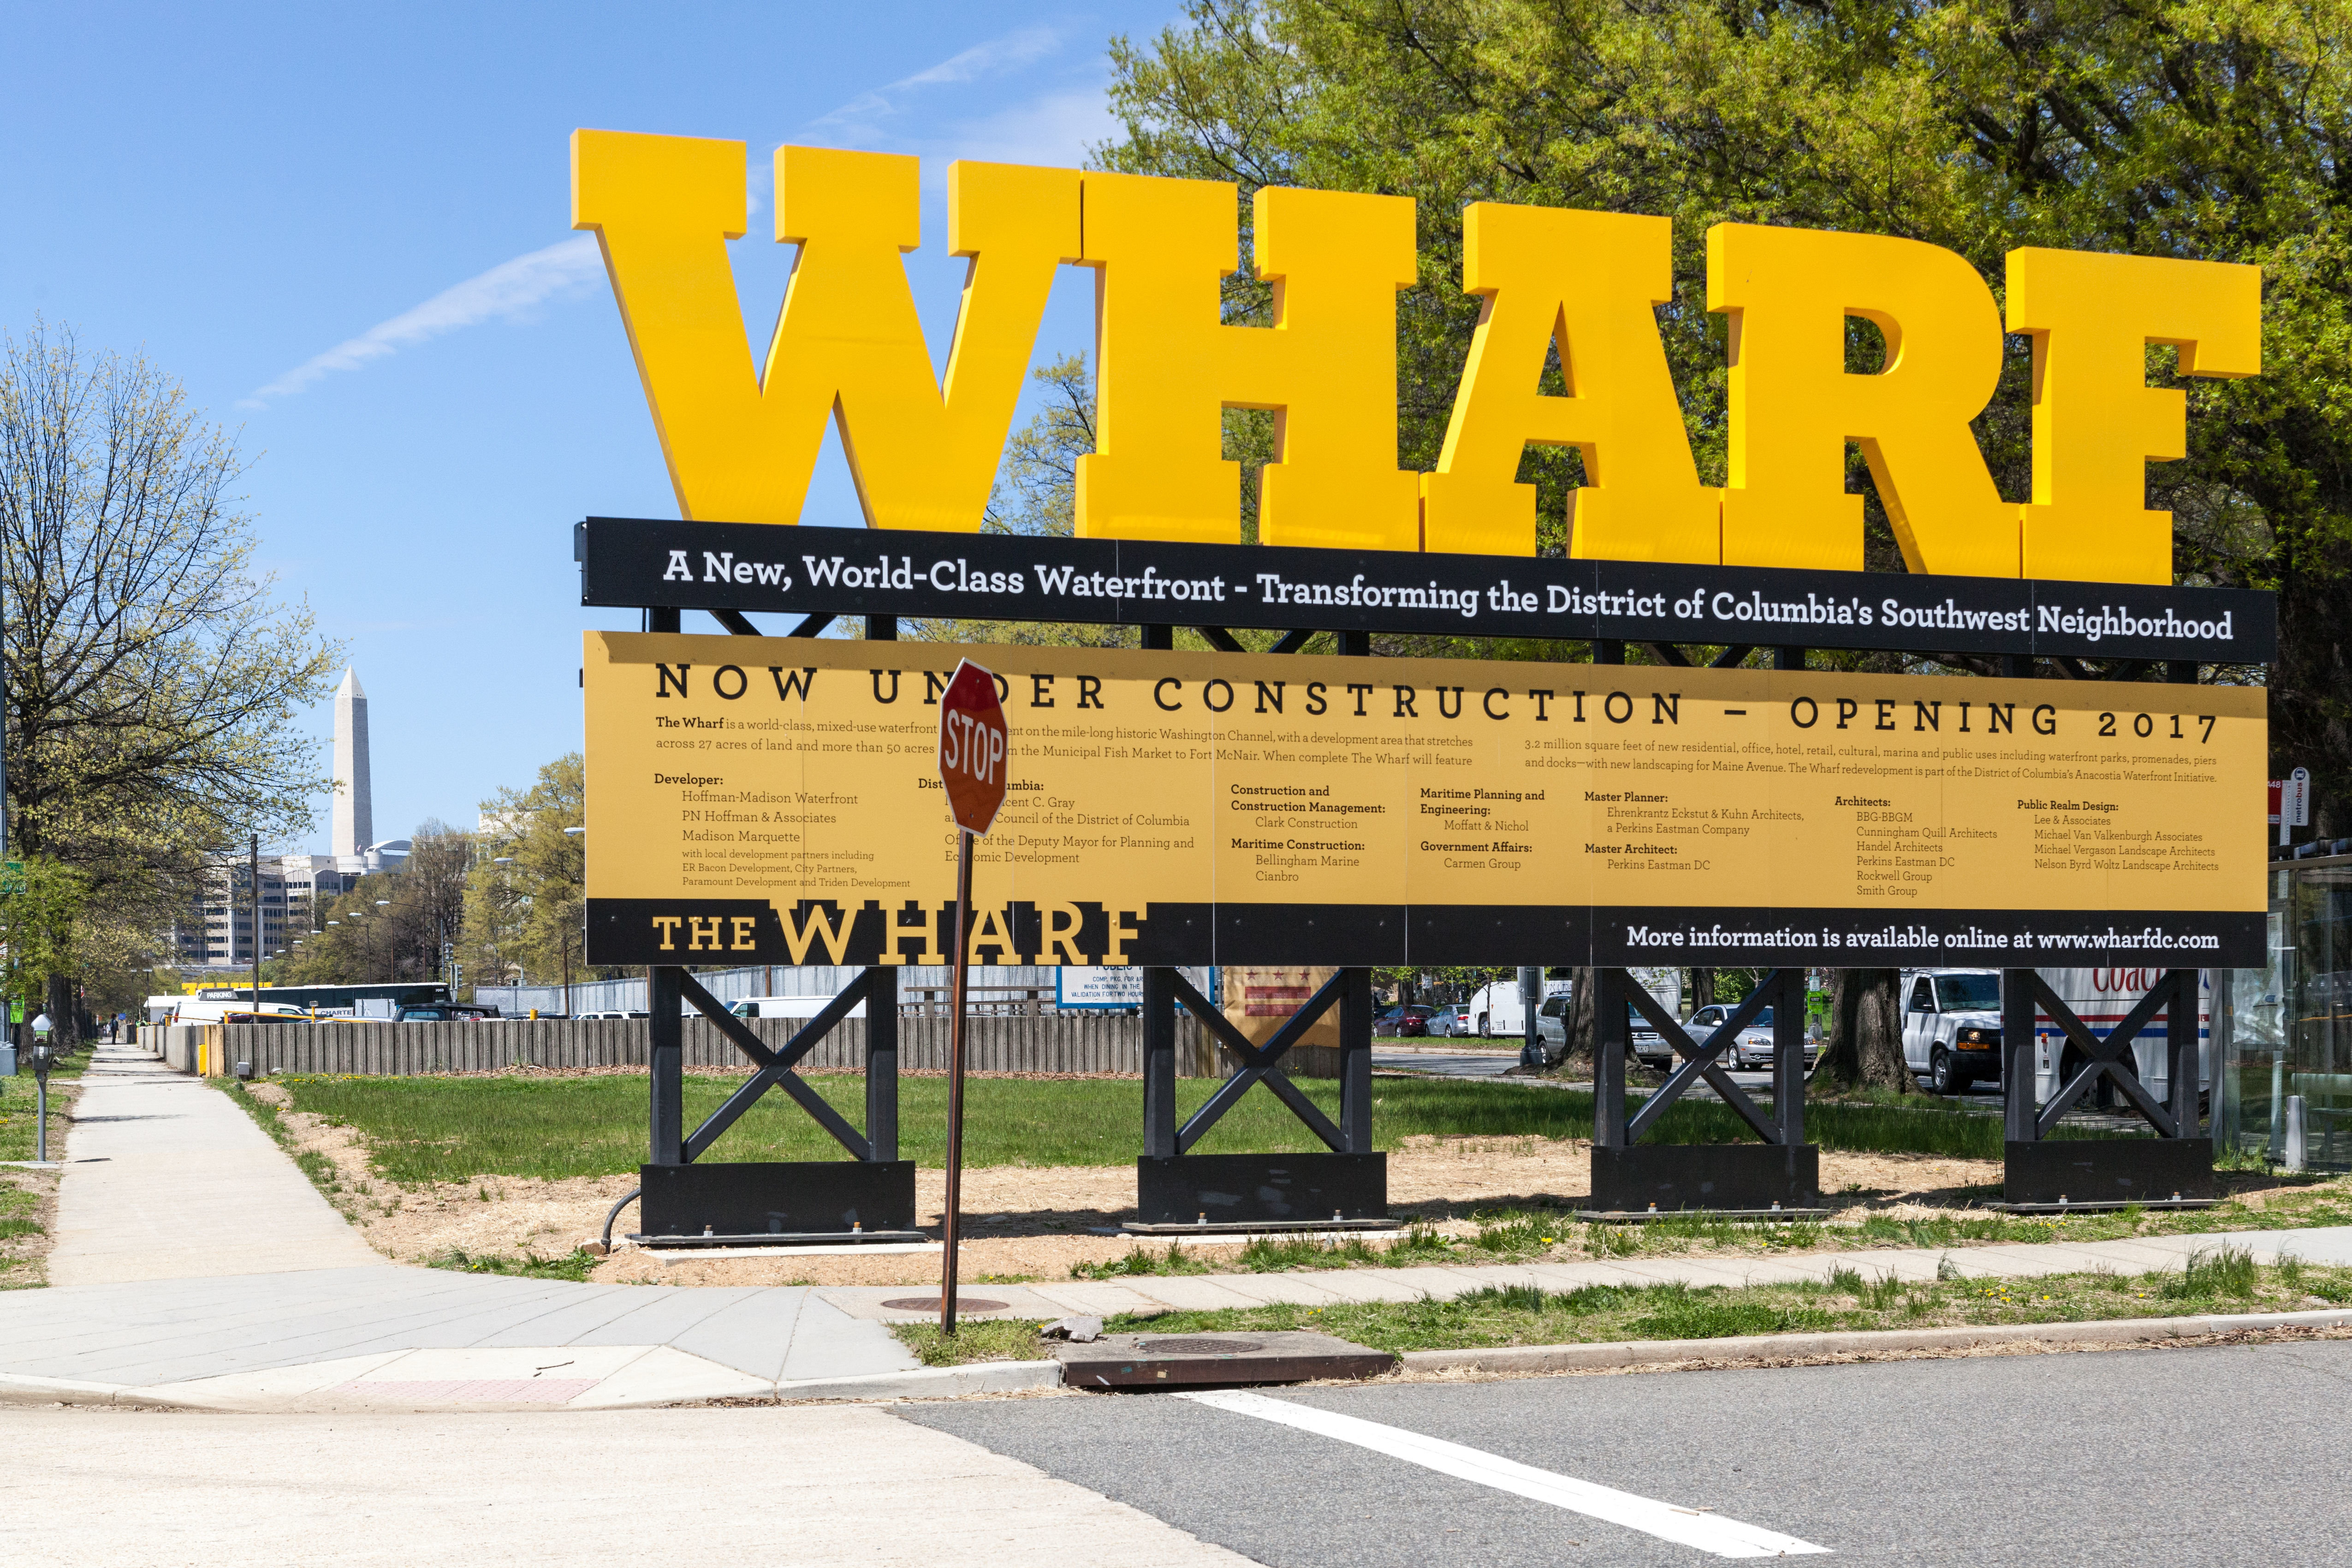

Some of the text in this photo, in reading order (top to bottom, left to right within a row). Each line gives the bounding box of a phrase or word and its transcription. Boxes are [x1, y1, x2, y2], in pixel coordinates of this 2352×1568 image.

[570, 129, 2261, 585] WHARF
[663, 550, 693, 581] A
[703, 552, 792, 592] New,
[802, 555, 1024, 593] World-Class
[1034, 564, 1225, 601] Waterfront
[1256, 573, 1479, 617] Transforming
[1487, 580, 1538, 612] the
[1547, 585, 1666, 617] District
[1674, 588, 1705, 618] of
[1712, 590, 1872, 625] Columbia's
[1881, 599, 2030, 631] Southwest
[2037, 605, 2233, 641] Neighborhood
[655, 663, 817, 701] NOW
[1154, 677, 1681, 725] CONSTRUCTION
[1791, 696, 2055, 735] OPENING
[2098, 712, 2216, 744] 2017
[655, 715, 680, 728] The
[682, 716, 725, 729] Wharf
[726, 718, 736, 730] is
[738, 722, 744, 730] a
[747, 718, 814, 733] world-class,
[817, 719, 877, 733] mixed-use
[879, 721, 938, 734] waterfront
[1026, 728, 1039, 736] on
[1042, 725, 1060, 737] the
[1062, 725, 1113, 741] mile-long
[1116, 726, 1157, 739] historic
[1159, 728, 1225, 743] Washington
[1228, 729, 1276, 743] Channel,
[1277, 731, 1301, 742] with
[1310, 731, 1378, 747] development
[1380, 737, 1403, 745] area
[1405, 734, 1425, 746] that
[1427, 735, 1473, 747] stretches
[944, 708, 1003, 785] STOP
[654, 772, 723, 788] Developer:
[682, 790, 858, 805] Hoffman-Madison Waterfront
[1230, 784, 1330, 796] Construction and
[1420, 787, 1545, 802] Maritime Planning and
[1584, 790, 1668, 803] Master Planner:
[1231, 800, 1385, 815] Construction Management:
[1834, 795, 1891, 807] Architects:
[2017, 799, 2119, 814] Public Realm Design:
[682, 809, 836, 824] PN Hoffman & Associates
[1420, 803, 1491, 818] Engineering:
[1607, 806, 1804, 821] Ehrenkrantz Eckstut & Kuhn Architects,
[1857, 811, 1913, 823] BBG-BBGM
[995, 812, 1189, 826] Council of the District of Columbia
[1255, 815, 1358, 829] Clark Construction
[1444, 819, 1528, 832] Moffatt & Nichol
[2034, 814, 2111, 826] Lee & Associates
[682, 829, 801, 844] Madison Marquette
[1616, 822, 1653, 833] Perkins
[1656, 823, 1699, 834] Eastman
[1702, 823, 1750, 837] Company
[1856, 826, 1997, 839] Cunningham Quill Architects
[2034, 828, 2203, 843] Michael Van Valkenburgh Associates
[1231, 837, 1365, 851] Maritime Construction:
[1420, 840, 1532, 853] Government Affairs:
[1585, 843, 1677, 855] Master Architect:
[1857, 840, 1943, 853] Handel Architects
[2034, 843, 2215, 858] Michael Vergason Landscape Architects
[1256, 854, 1360, 868] Bellingham Marine
[1444, 857, 1521, 872] Carmen Group
[1607, 858, 1710, 871] Perkins Eastman DC
[1857, 855, 1955, 867] Perkins Eastman DC
[2034, 858, 2219, 873] Nelson Byrd Woltz Landscape Architects
[1255, 870, 1299, 882] Cianbro
[1857, 869, 1932, 884] Rockwell Group
[1857, 884, 1918, 898] Smith Group
[653, 898, 1147, 965] THE WHARF
[1627, 924, 2220, 948] More information is available online at www.wharfdc.com
